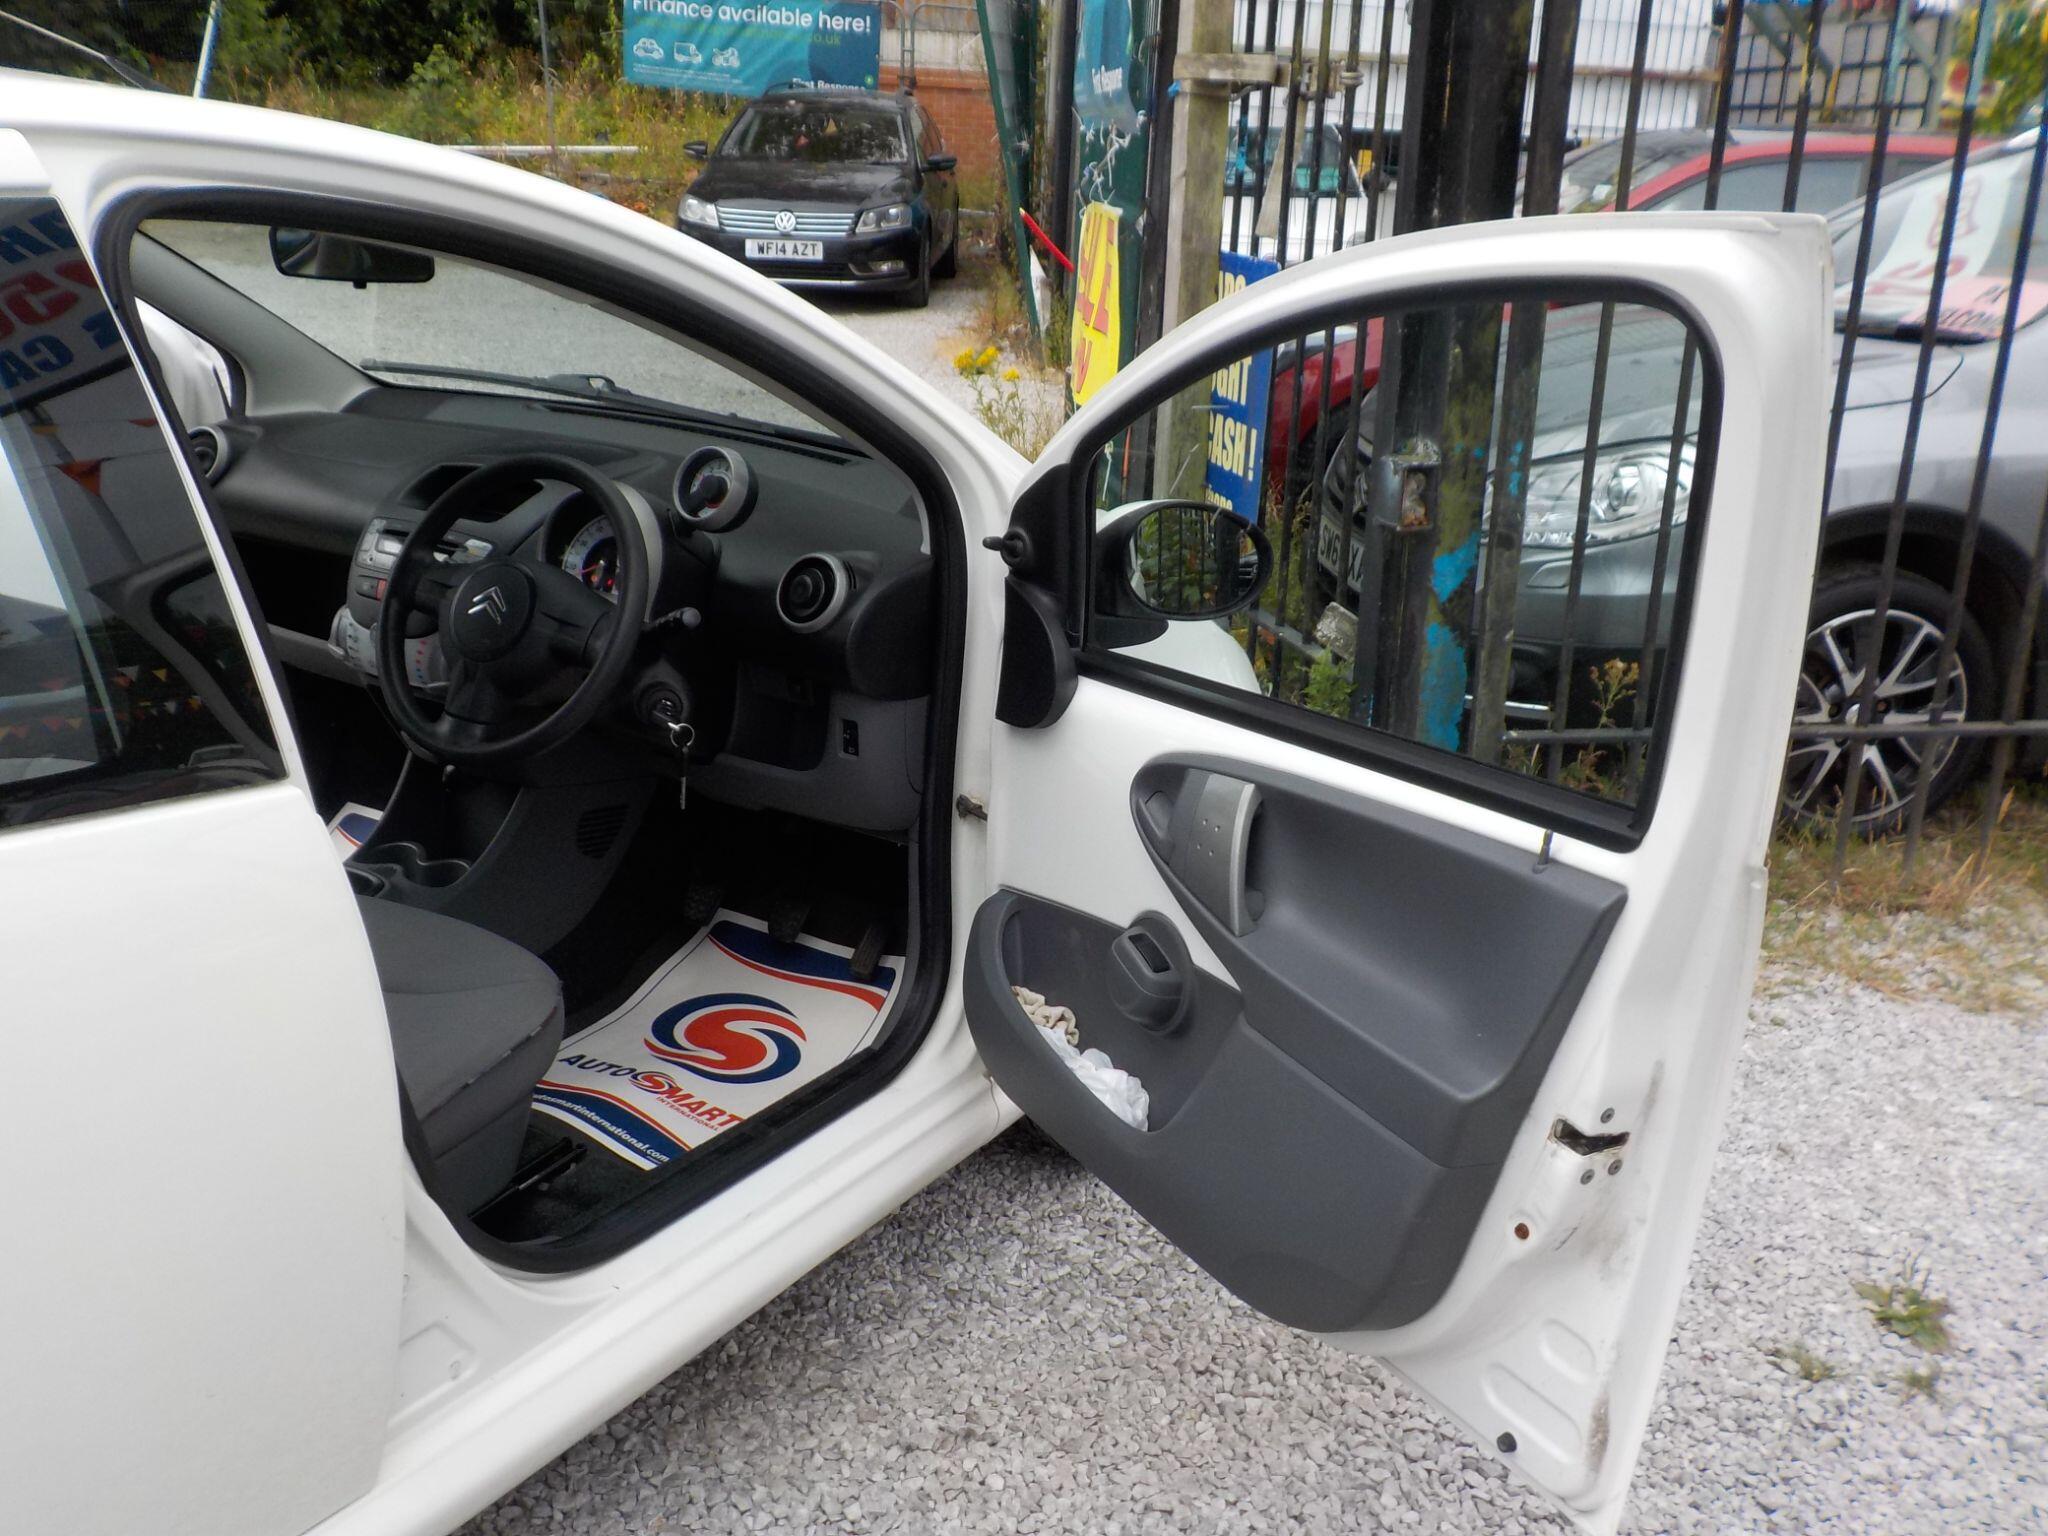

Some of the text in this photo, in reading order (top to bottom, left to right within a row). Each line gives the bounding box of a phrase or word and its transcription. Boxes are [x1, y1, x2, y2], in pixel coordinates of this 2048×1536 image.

[718, 2, 812, 28] available
[818, 11, 871, 33] here!
[757, 241, 817, 257] WF14 AZT
[656, 1096, 720, 1132] INTERNATIONAL
